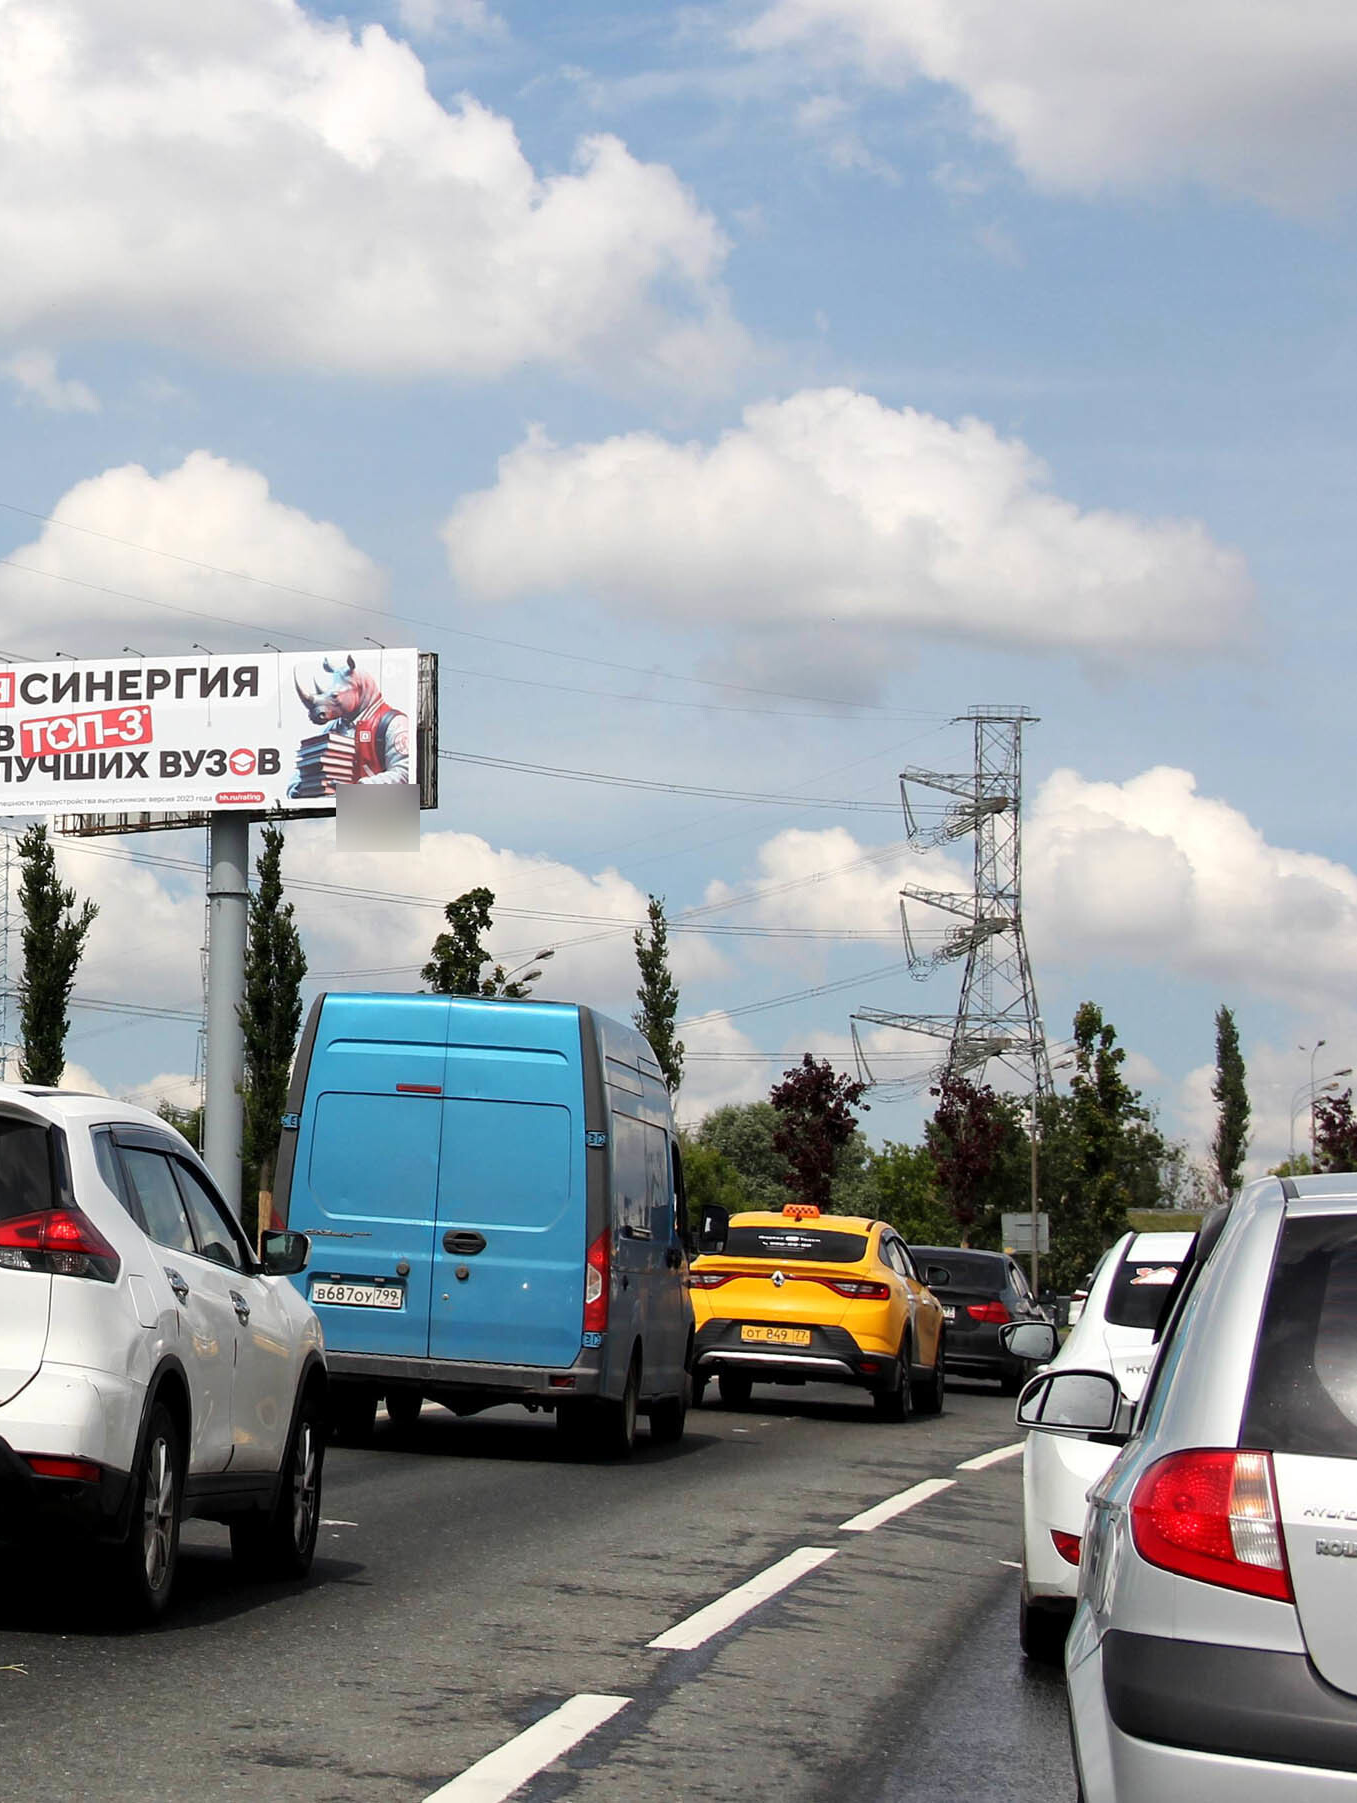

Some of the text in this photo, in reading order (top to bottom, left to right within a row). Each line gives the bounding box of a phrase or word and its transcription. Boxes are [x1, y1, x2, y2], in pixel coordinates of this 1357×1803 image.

[20, 666, 259, 704] СИНЕРГИЯ
[375, 1289, 397, 1301] 799
[766, 1328, 788, 1340] 849
[795, 1330, 806, 1339] 77
